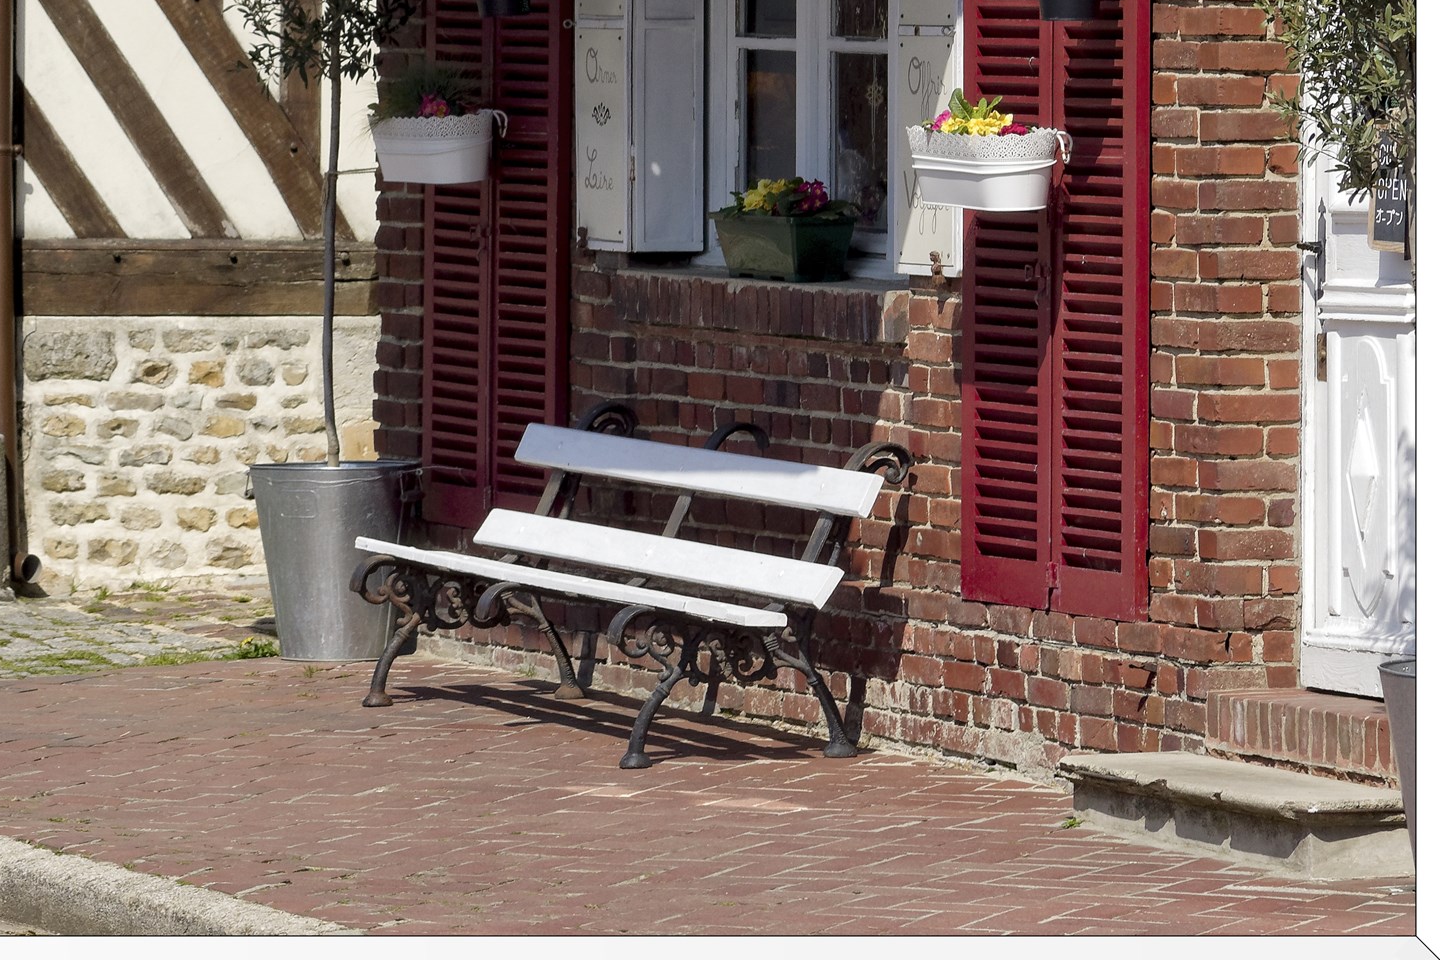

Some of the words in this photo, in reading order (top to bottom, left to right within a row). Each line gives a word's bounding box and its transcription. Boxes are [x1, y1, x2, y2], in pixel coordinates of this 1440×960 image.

[585, 47, 618, 84] Orner
[907, 56, 948, 121] Offrir
[584, 145, 614, 191] Lire
[1377, 177, 1408, 200] OPEN
[1375, 208, 1404, 225] オープン
